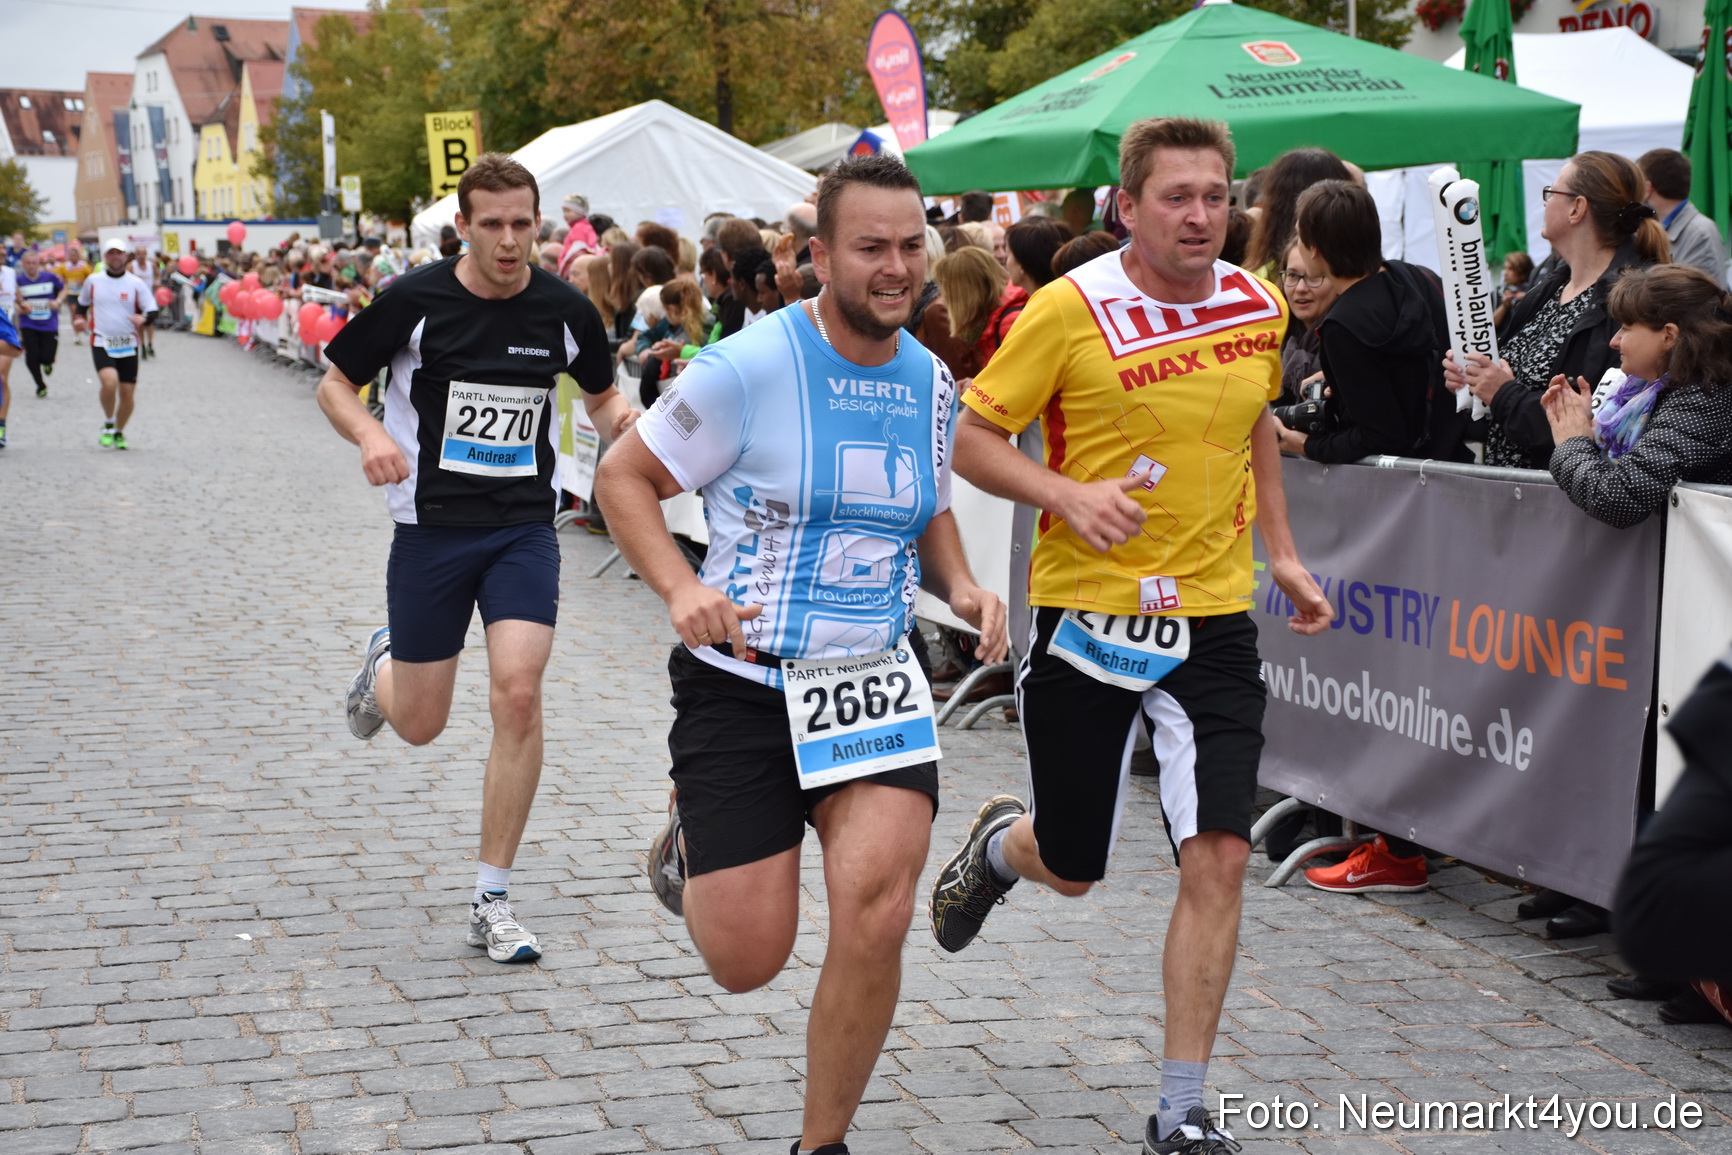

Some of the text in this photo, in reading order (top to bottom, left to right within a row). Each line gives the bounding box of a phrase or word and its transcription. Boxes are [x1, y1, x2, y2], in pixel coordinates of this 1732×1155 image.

[1225, 67, 1362, 85] Neumarkter
[432, 116, 475, 132] Block
[443, 138, 470, 176] B
[514, 347, 550, 357] PFLEIDERER
[1117, 331, 1280, 392] MAX BÖGL
[451, 390, 531, 405] PARTL Neumarkt
[826, 377, 918, 404] VIERTL
[968, 382, 1009, 417] oegl.de
[828, 398, 919, 420] DESIGN GmbH
[456, 405, 534, 442] 2270
[467, 446, 517, 464] Andreas
[838, 506, 912, 523] slacklinebox
[726, 533, 760, 607] RTL
[816, 588, 890, 605] raumbox
[1266, 573, 1440, 649] INUSTRY
[1448, 599, 1627, 691] LOUNGE
[786, 656, 893, 682] PARTL Neumarkt
[1084, 640, 1150, 676] Richard
[803, 671, 919, 734] 2662
[1264, 656, 1534, 772] w.bockonline.de
[832, 733, 906, 762] Andreas
